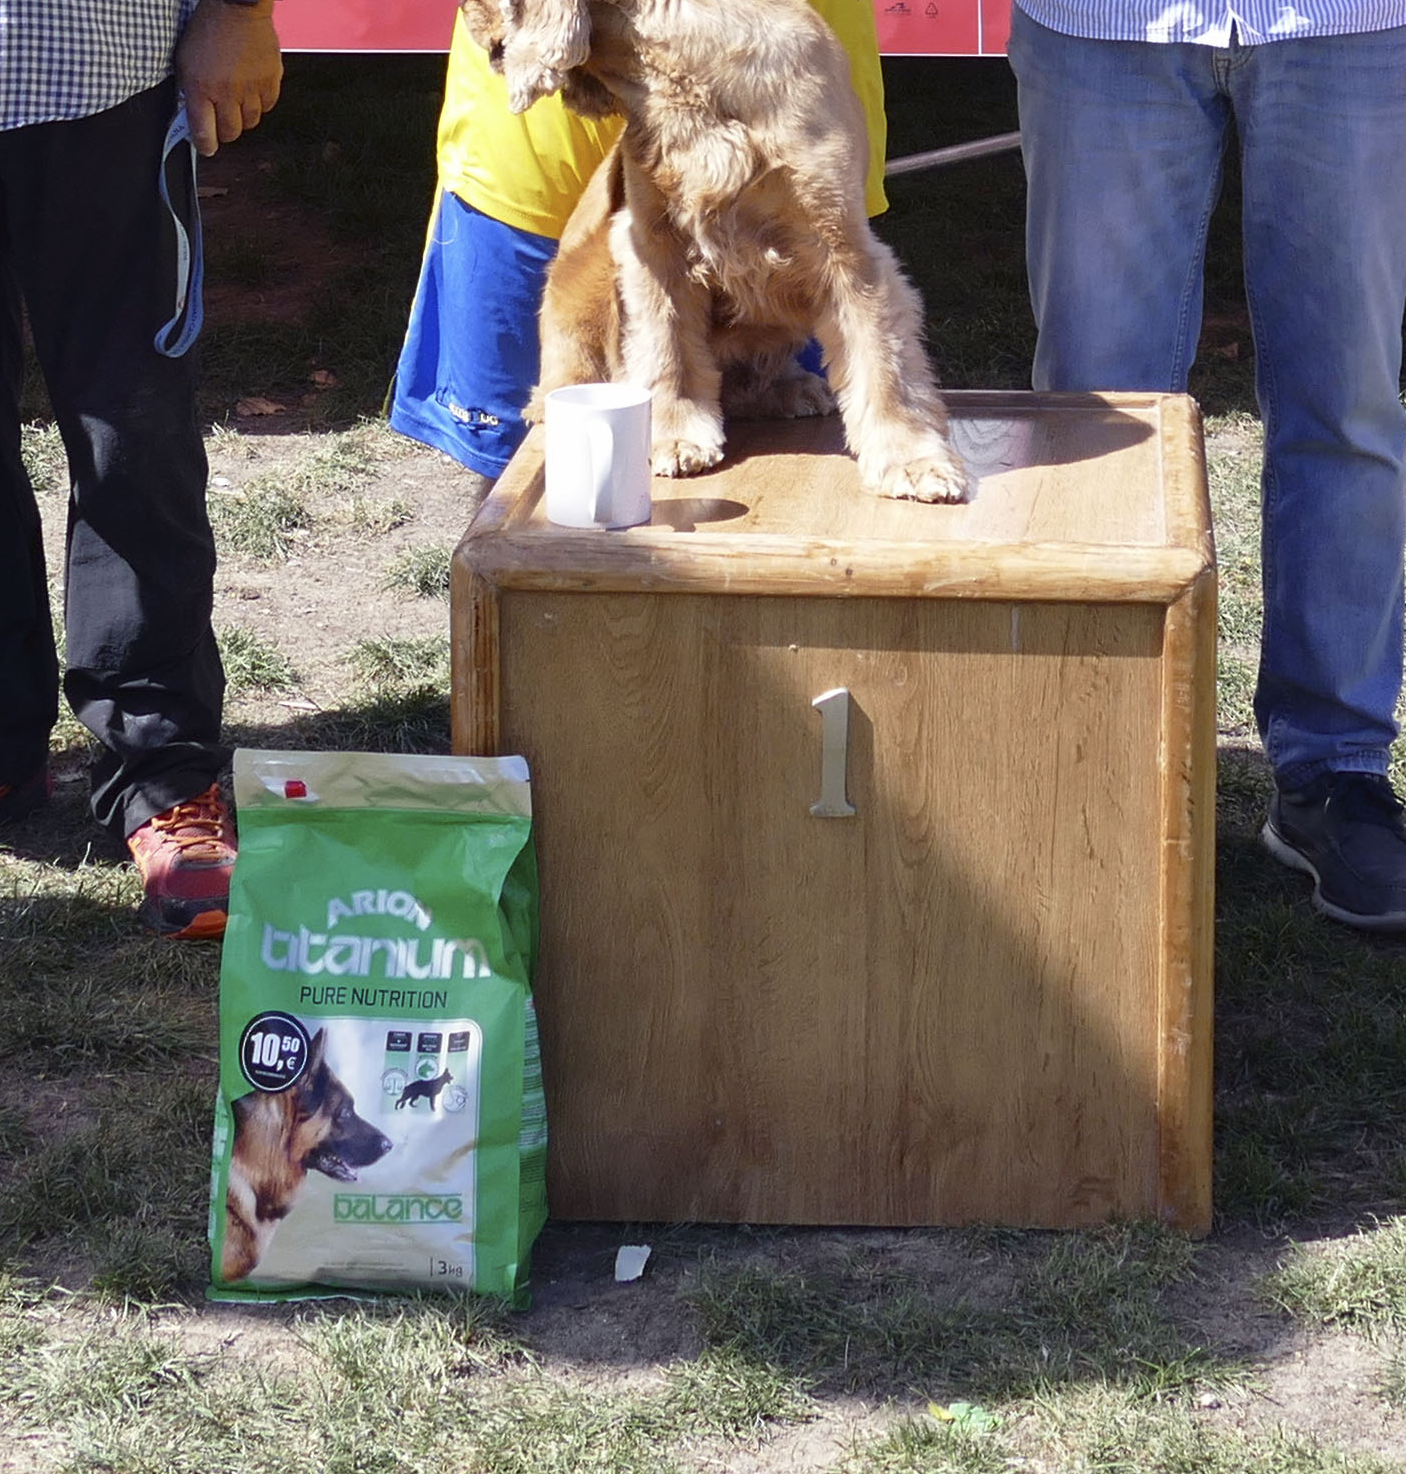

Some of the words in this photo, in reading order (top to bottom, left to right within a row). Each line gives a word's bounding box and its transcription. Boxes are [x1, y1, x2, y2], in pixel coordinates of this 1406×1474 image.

[809, 686, 857, 817] 1
[327, 889, 432, 931] ARION
[261, 922, 491, 979] titanium
[299, 986, 347, 1005] PURE
[351, 989, 447, 1009] NUTRITION
[334, 1194, 462, 1223] balance
